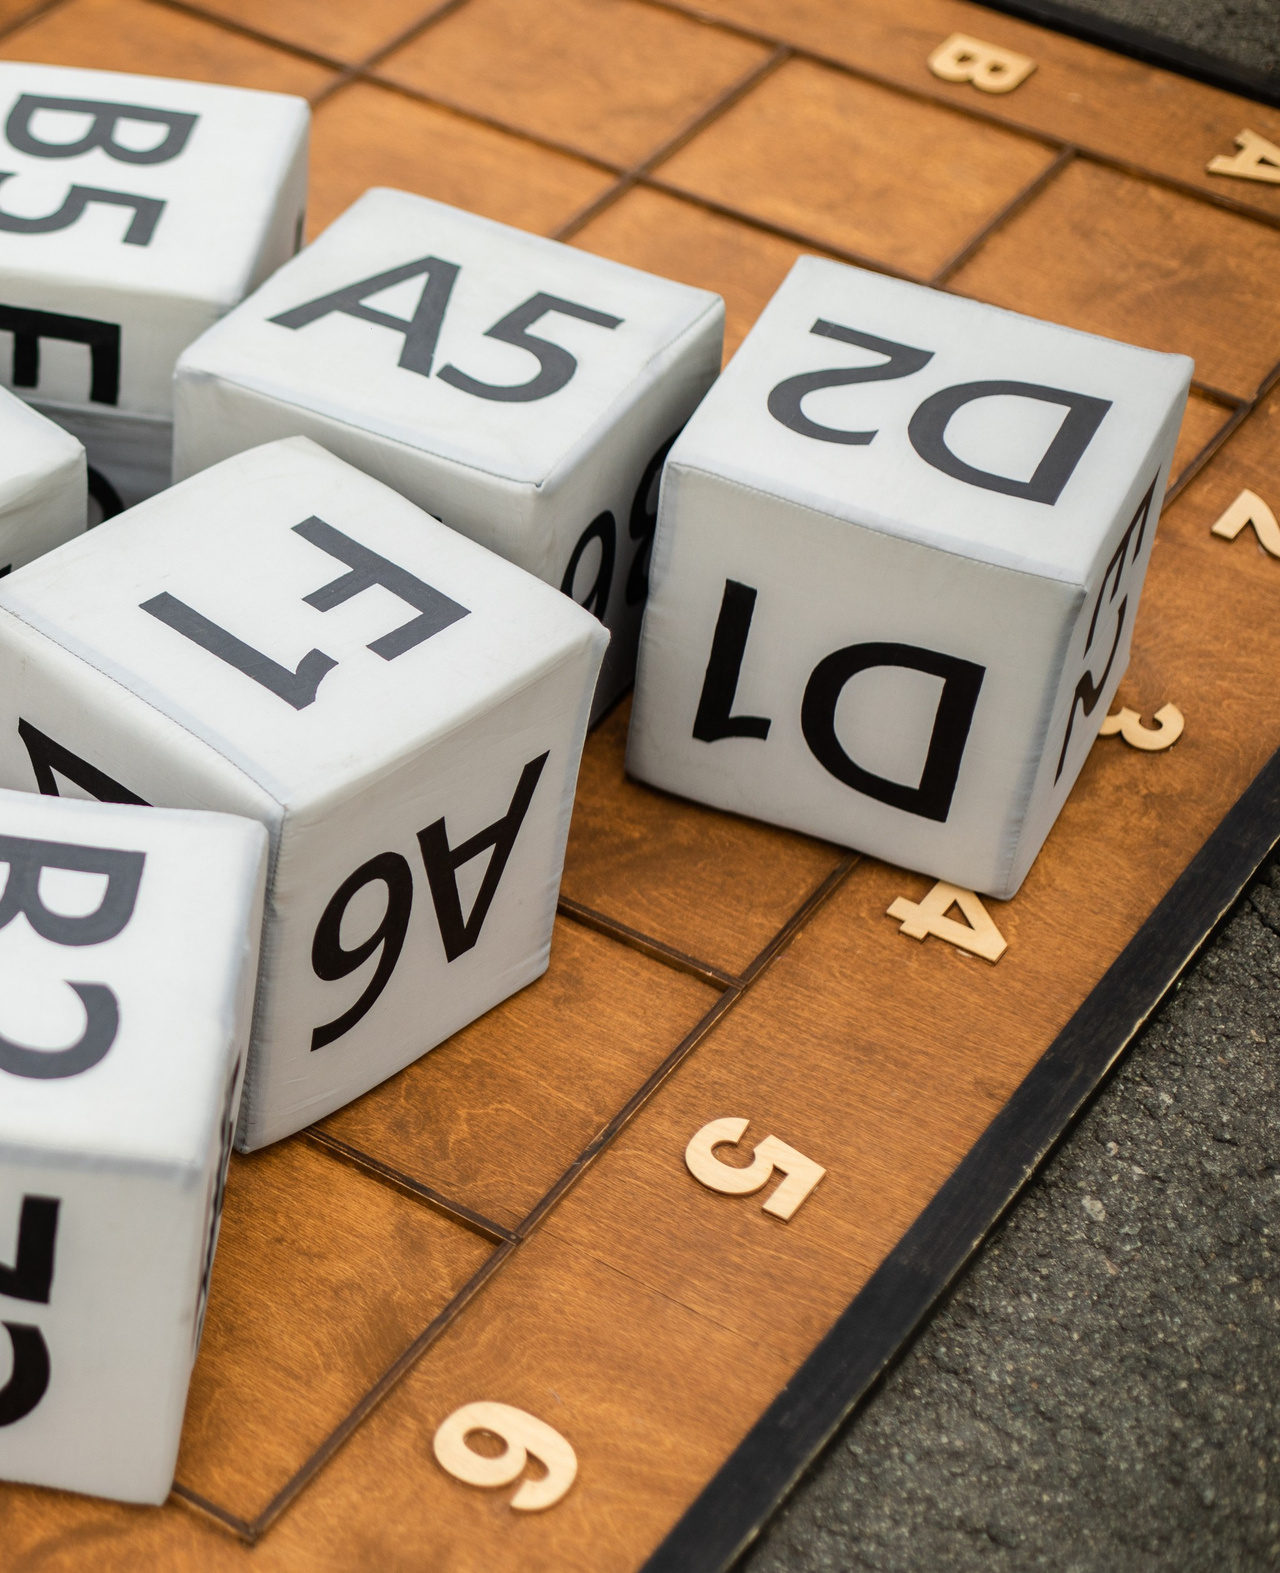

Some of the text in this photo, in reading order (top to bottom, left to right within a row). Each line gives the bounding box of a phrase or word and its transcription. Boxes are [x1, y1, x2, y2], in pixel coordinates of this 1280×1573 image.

[927, 31, 1038, 94] B
[1206, 127, 1280, 185] A
[265, 255, 625, 403] A5
[767, 318, 1113, 506] D2
[138, 515, 472, 711] F1
[692, 577, 987, 823] D1
[311, 749, 551, 1052] A6
[886, 878, 1009, 966] 4
[684, 1116, 827, 1224] 5
[433, 1400, 579, 1512] 6
